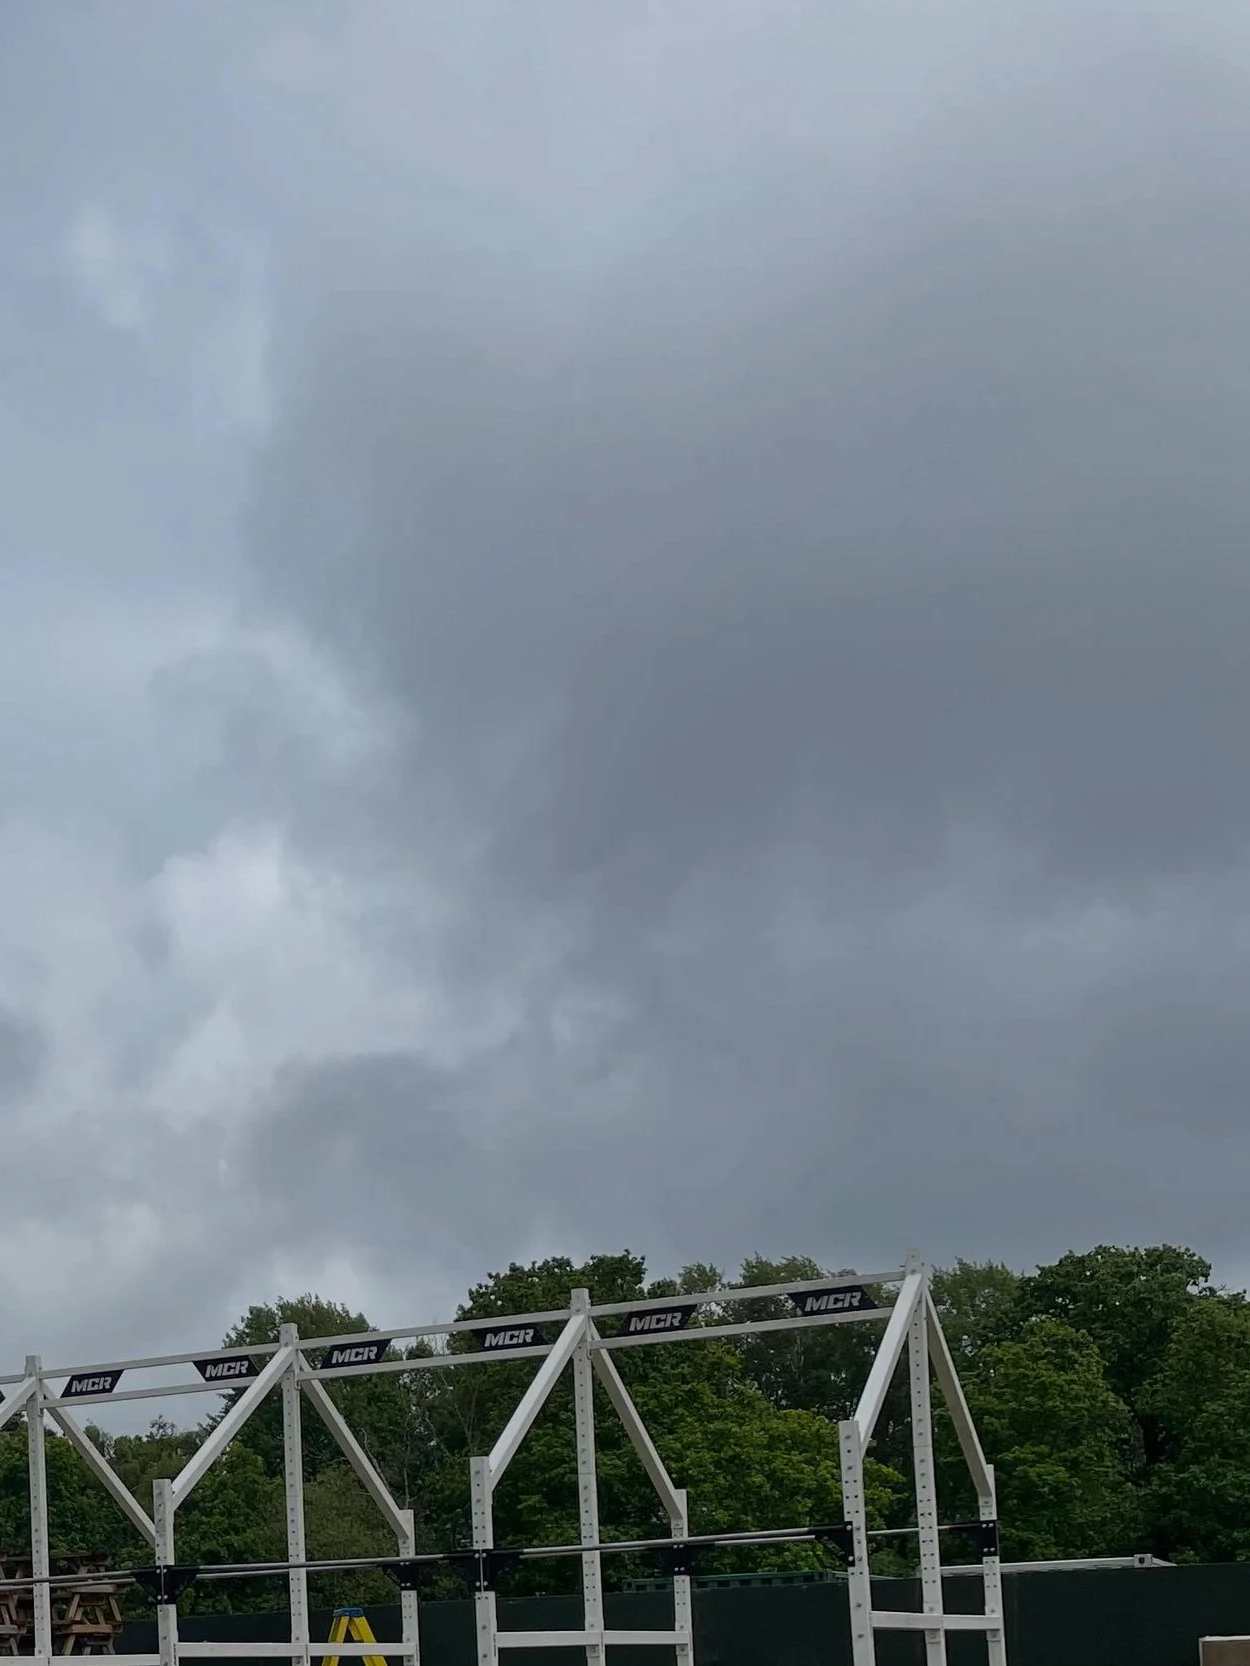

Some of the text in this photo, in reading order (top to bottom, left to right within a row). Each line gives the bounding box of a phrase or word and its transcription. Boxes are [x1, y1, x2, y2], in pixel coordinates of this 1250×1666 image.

[805, 1291, 862, 1311] MCR
[629, 1312, 682, 1331] MCR
[484, 1328, 534, 1347] MCR
[331, 1346, 378, 1363] MCR
[205, 1360, 249, 1378] MCR
[70, 1376, 112, 1392] MCR
